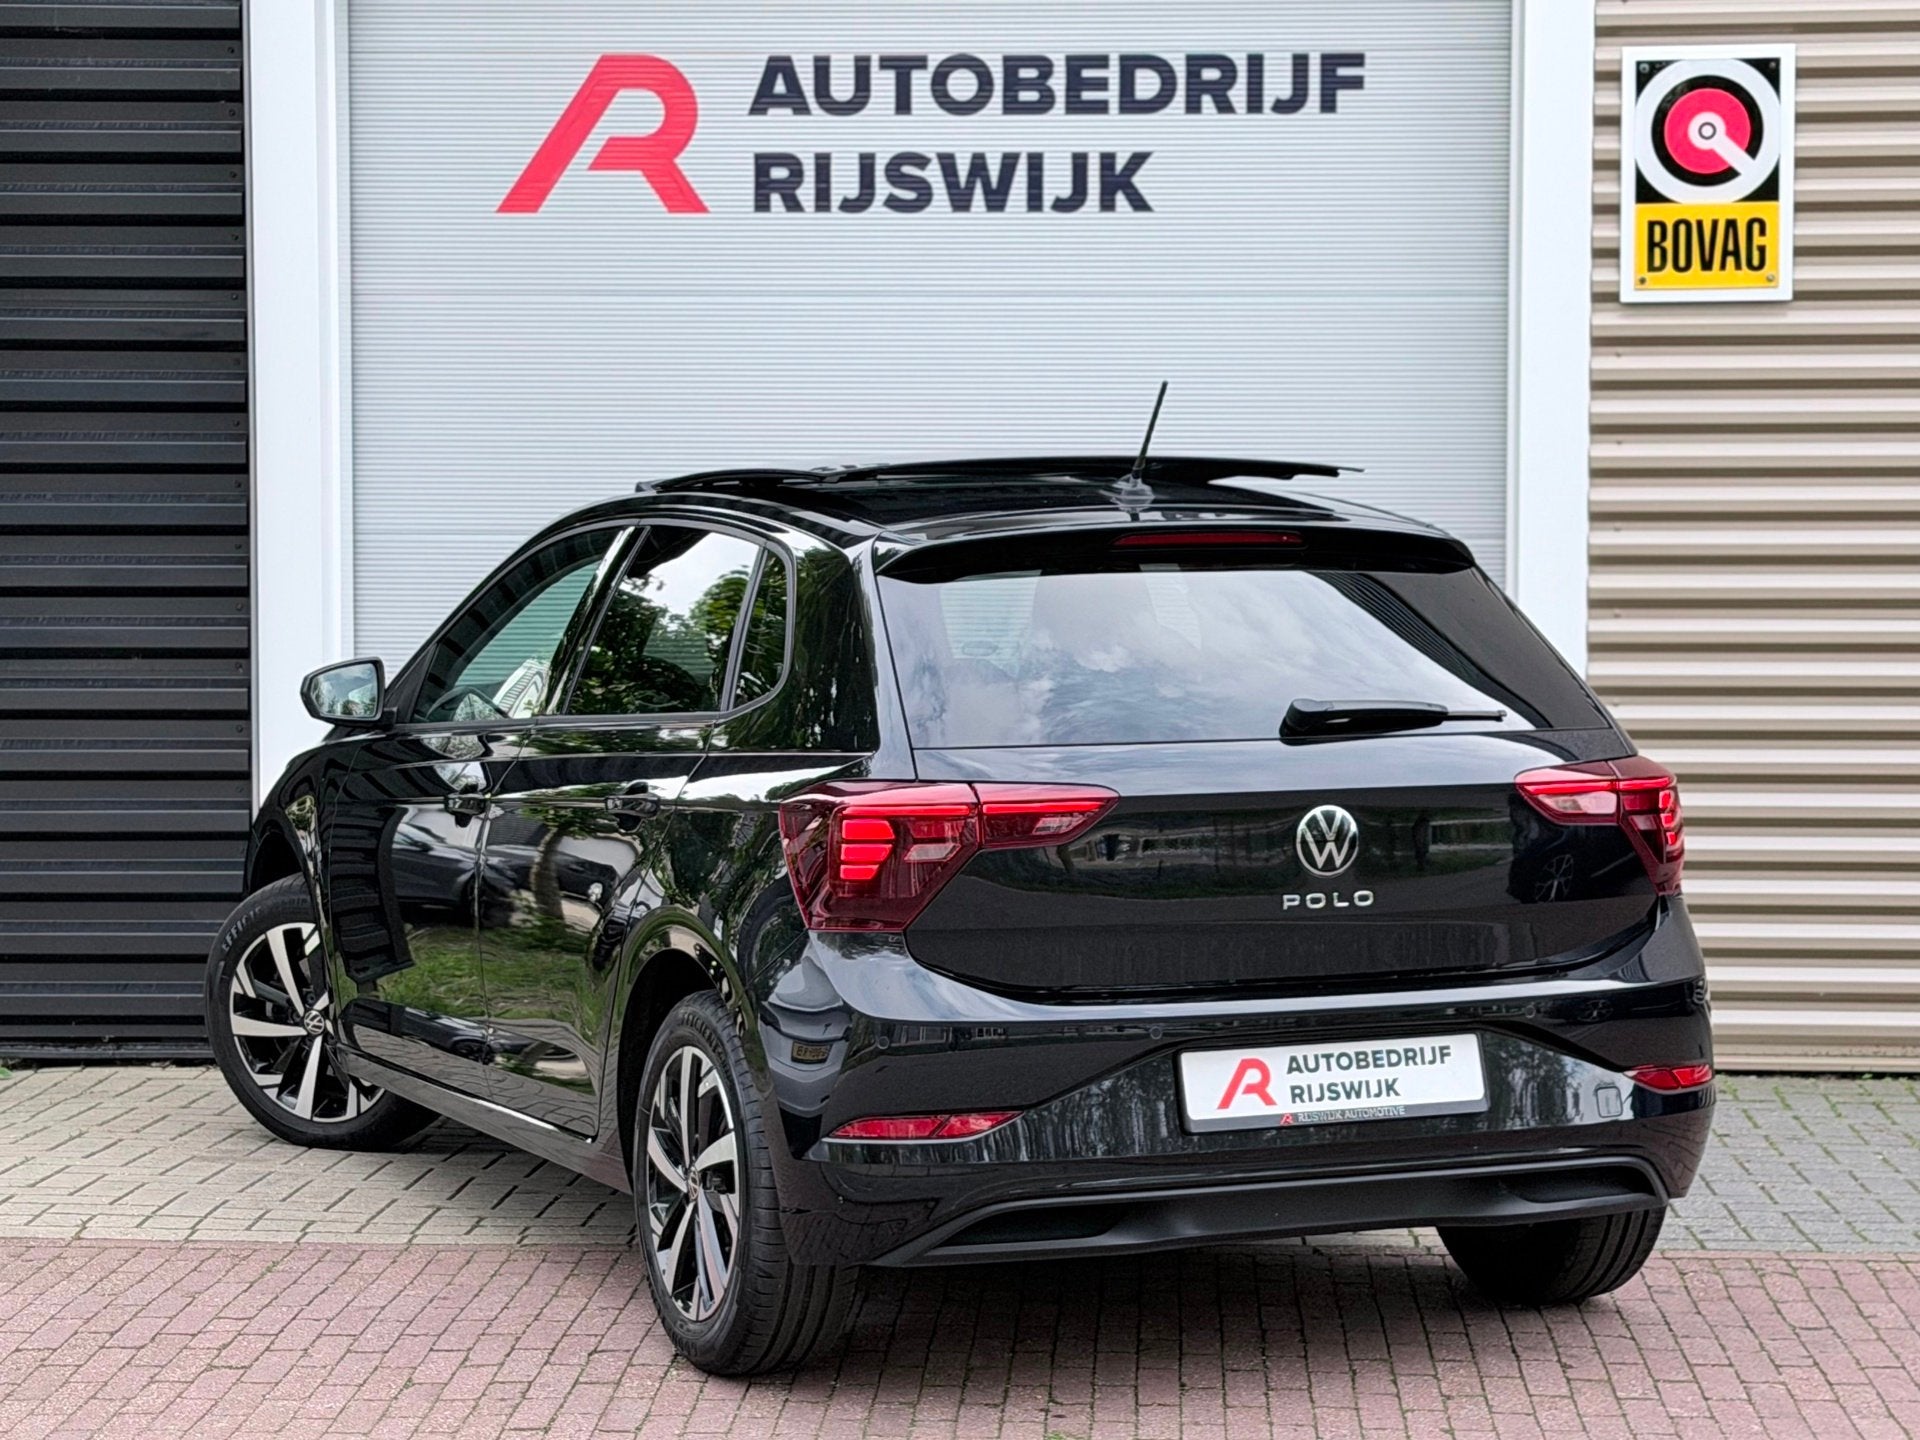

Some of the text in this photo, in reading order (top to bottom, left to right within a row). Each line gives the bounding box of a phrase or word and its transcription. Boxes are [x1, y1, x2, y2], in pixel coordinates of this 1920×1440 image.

[748, 52, 1365, 116] AUTOBEDRIJF
[753, 151, 1153, 214] RIJSWIJK
[1647, 217, 1767, 273] BOVAG
[1282, 889, 1375, 910] POLO
[1286, 1045, 1452, 1075] AUTOBEDRIJF
[1290, 1078, 1401, 1104] RIJSWIJK
[1344, 1104, 1406, 1120] AUTOMOTIVE
